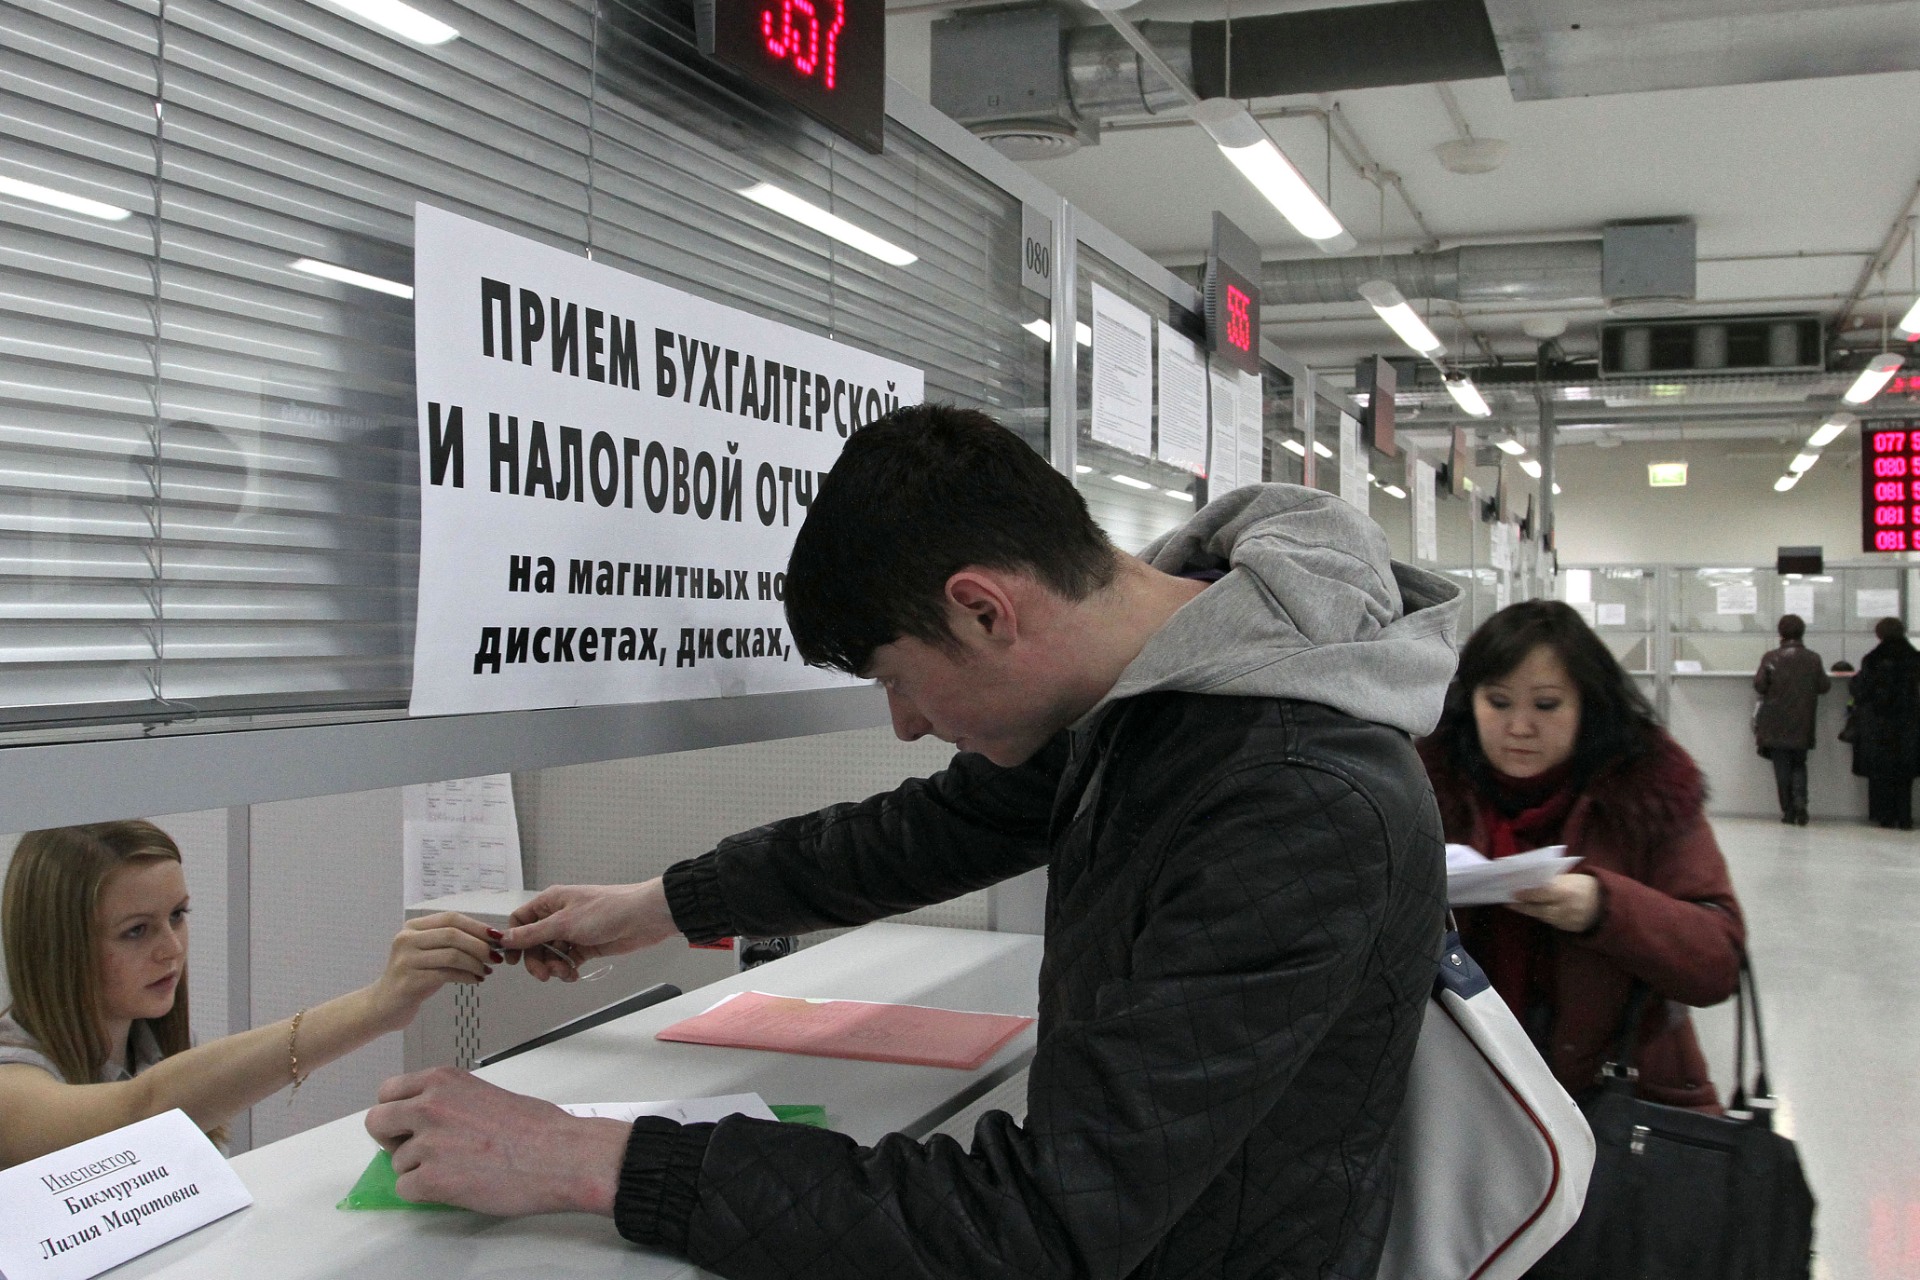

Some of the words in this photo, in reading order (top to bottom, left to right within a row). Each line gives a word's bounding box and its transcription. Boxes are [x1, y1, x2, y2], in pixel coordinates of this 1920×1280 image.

[1026, 237, 1049, 279] 080
[481, 277, 640, 390] ПРИЕМ
[655, 328, 900, 438] БУХГАЛТЕРСКОЙ
[1874, 431, 1906, 452] 077
[428, 402, 464, 489] И
[488, 412, 742, 523] НАЛОГОВОЙ
[756, 461, 827, 527] ОТЧ
[1874, 457, 1907, 477] 080
[1874, 481, 1906, 501] 081
[1875, 506, 1906, 526] 081
[1875, 530, 1906, 550] 081
[509, 554, 555, 592] на
[568, 559, 748, 600] магнитных
[473, 627, 667, 674] дискетах,
[677, 627, 790, 667] дисках,
[41, 1148, 139, 1193] Инспектор
[63, 1164, 169, 1215] Бикмурзина
[39, 1225, 102, 1259] Лилия
[101, 1182, 200, 1232] Маратовна
